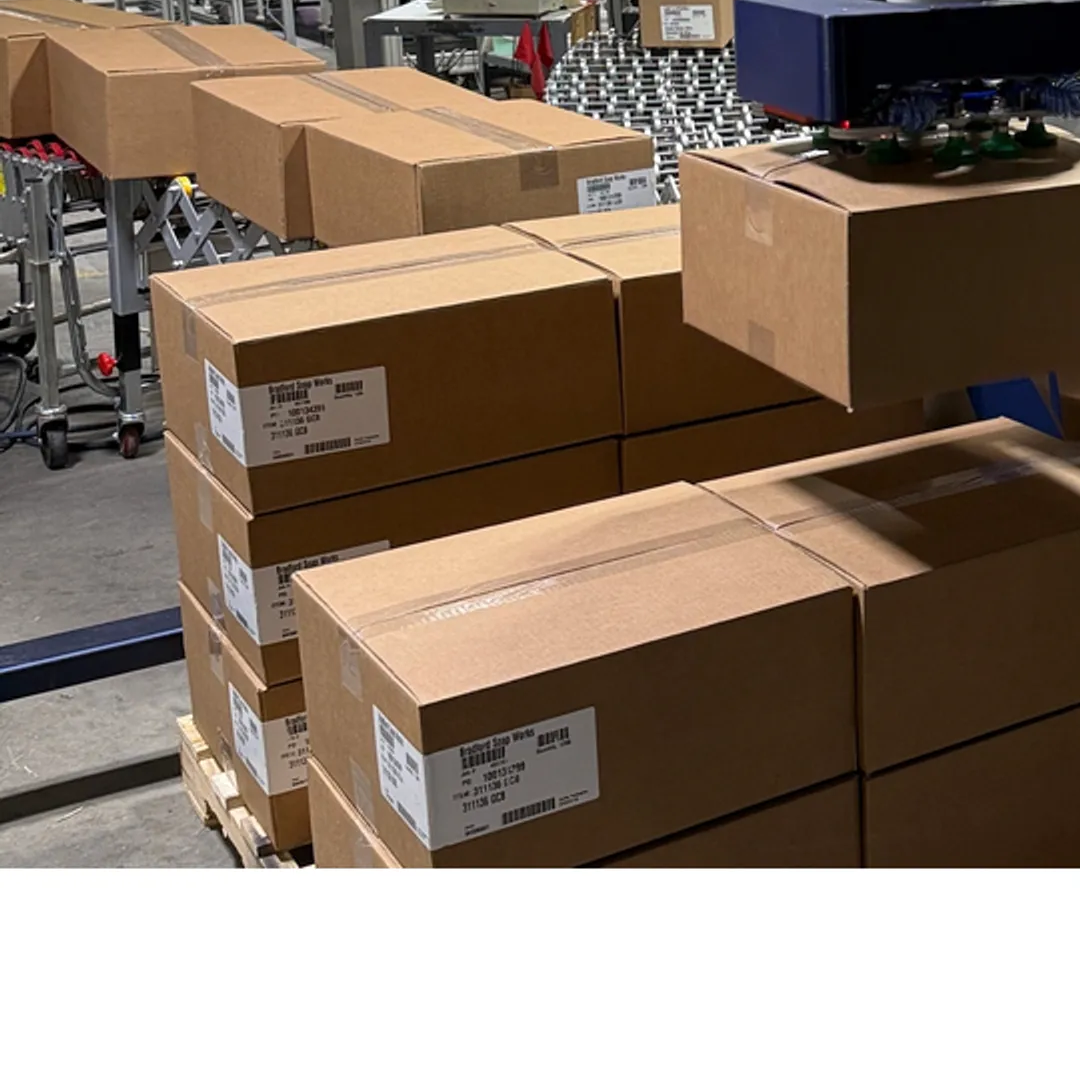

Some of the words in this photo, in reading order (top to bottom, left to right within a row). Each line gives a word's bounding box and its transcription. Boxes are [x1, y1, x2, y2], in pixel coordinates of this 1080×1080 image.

[268, 382, 295, 394] Bradford
[296, 380, 312, 390] Soap
[314, 377, 333, 387] Works
[460, 740, 491, 758] Bradford
[491, 735, 511, 748] Soap
[511, 728, 535, 742] Works
